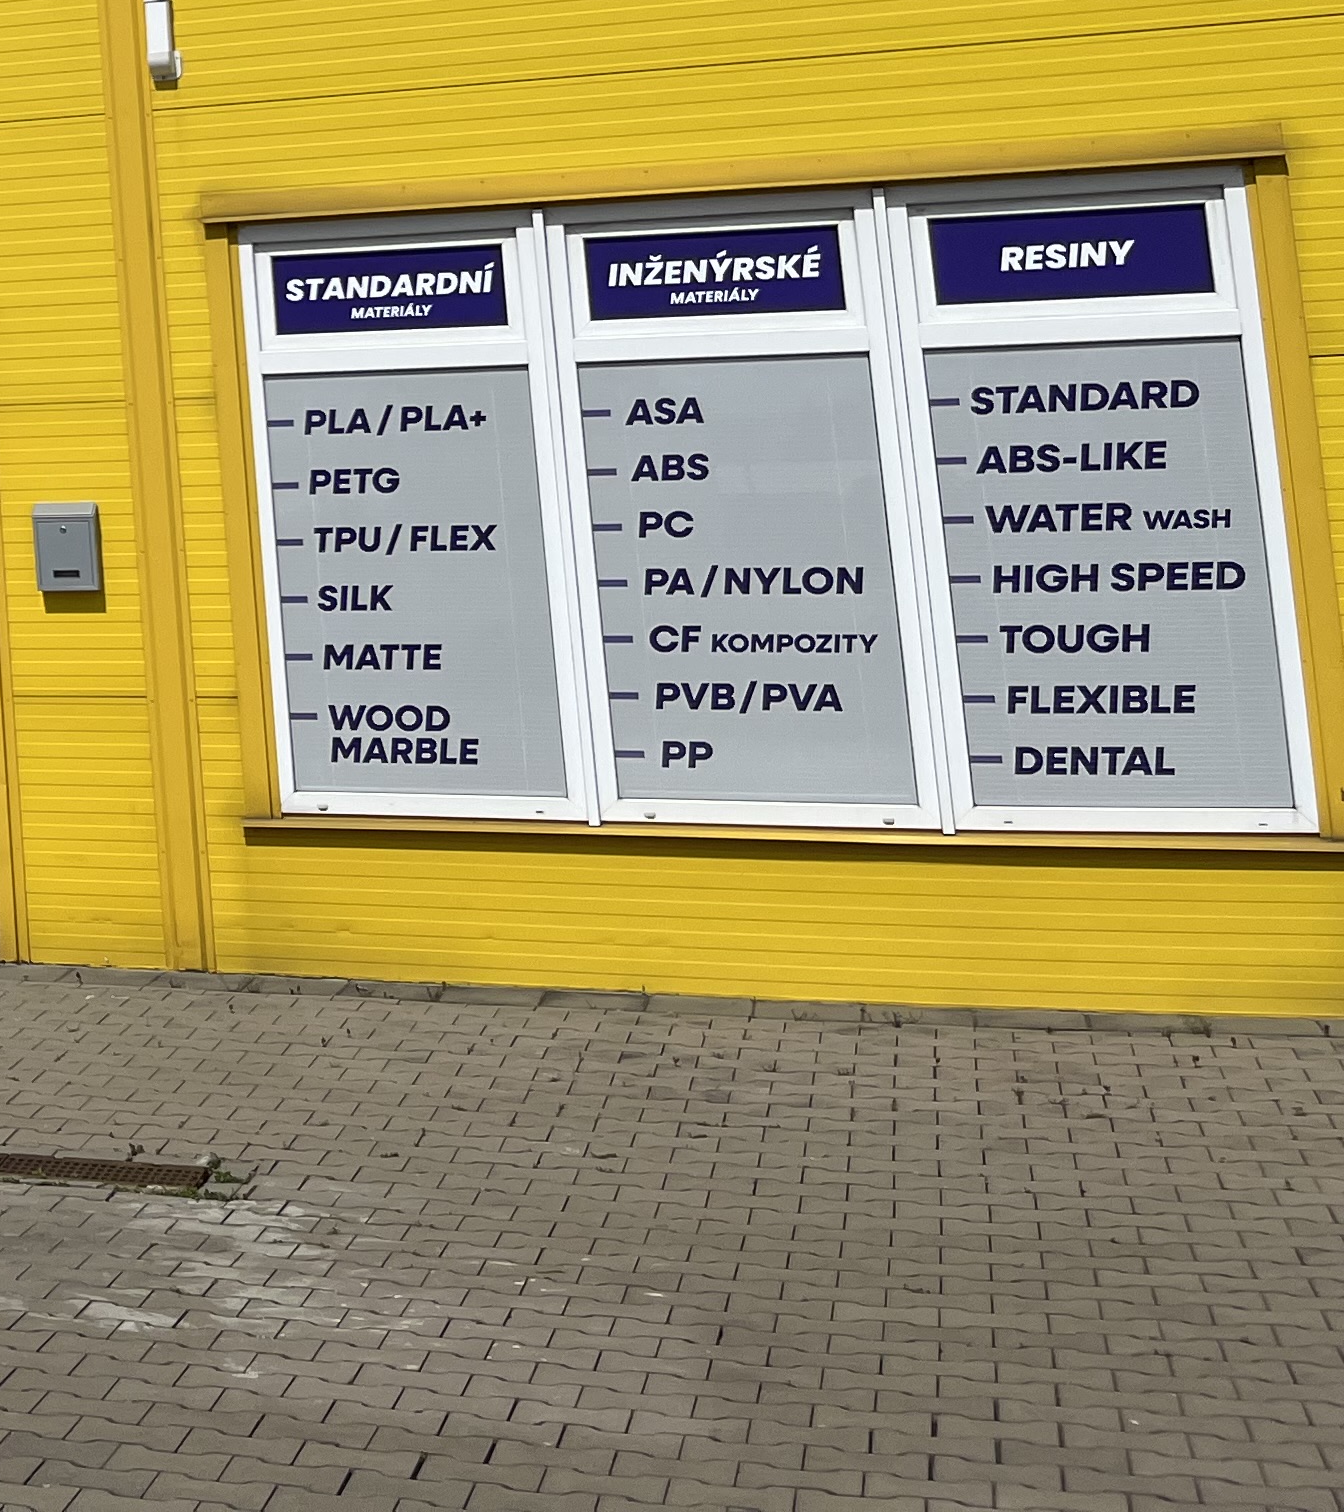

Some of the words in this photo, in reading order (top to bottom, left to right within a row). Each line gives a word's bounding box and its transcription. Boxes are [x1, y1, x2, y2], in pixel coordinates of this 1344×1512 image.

[608, 245, 821, 287] INŽENÝRSKÉ
[1001, 240, 1134, 271] RESINY
[286, 262, 494, 301] STANDARDNÍ
[671, 287, 759, 304] MATERIÁLY
[351, 303, 432, 318] MATERIÁLY
[626, 397, 704, 425] ASA
[971, 380, 1199, 415] STANDARD
[631, 454, 709, 481] ABS
[977, 441, 1166, 474] ABS-LIKE
[310, 468, 400, 494] PETG
[639, 511, 693, 538] PC
[985, 503, 1132, 533] WATER
[1143, 509, 1231, 529] WASH
[993, 564, 1098, 593] HIGH
[1111, 562, 1245, 591] SPEED
[318, 585, 393, 611] SILK
[650, 626, 701, 652] CF
[712, 634, 878, 653] KOMPOZITY
[1000, 624, 1150, 653] TOUGH
[324, 644, 442, 670] MATTE
[1008, 685, 1196, 714] FLEXIBLE
[328, 705, 450, 731] WOOD
[331, 737, 479, 765] MARBLE
[662, 741, 713, 768] PP
[1015, 747, 1175, 775] DENTAL
